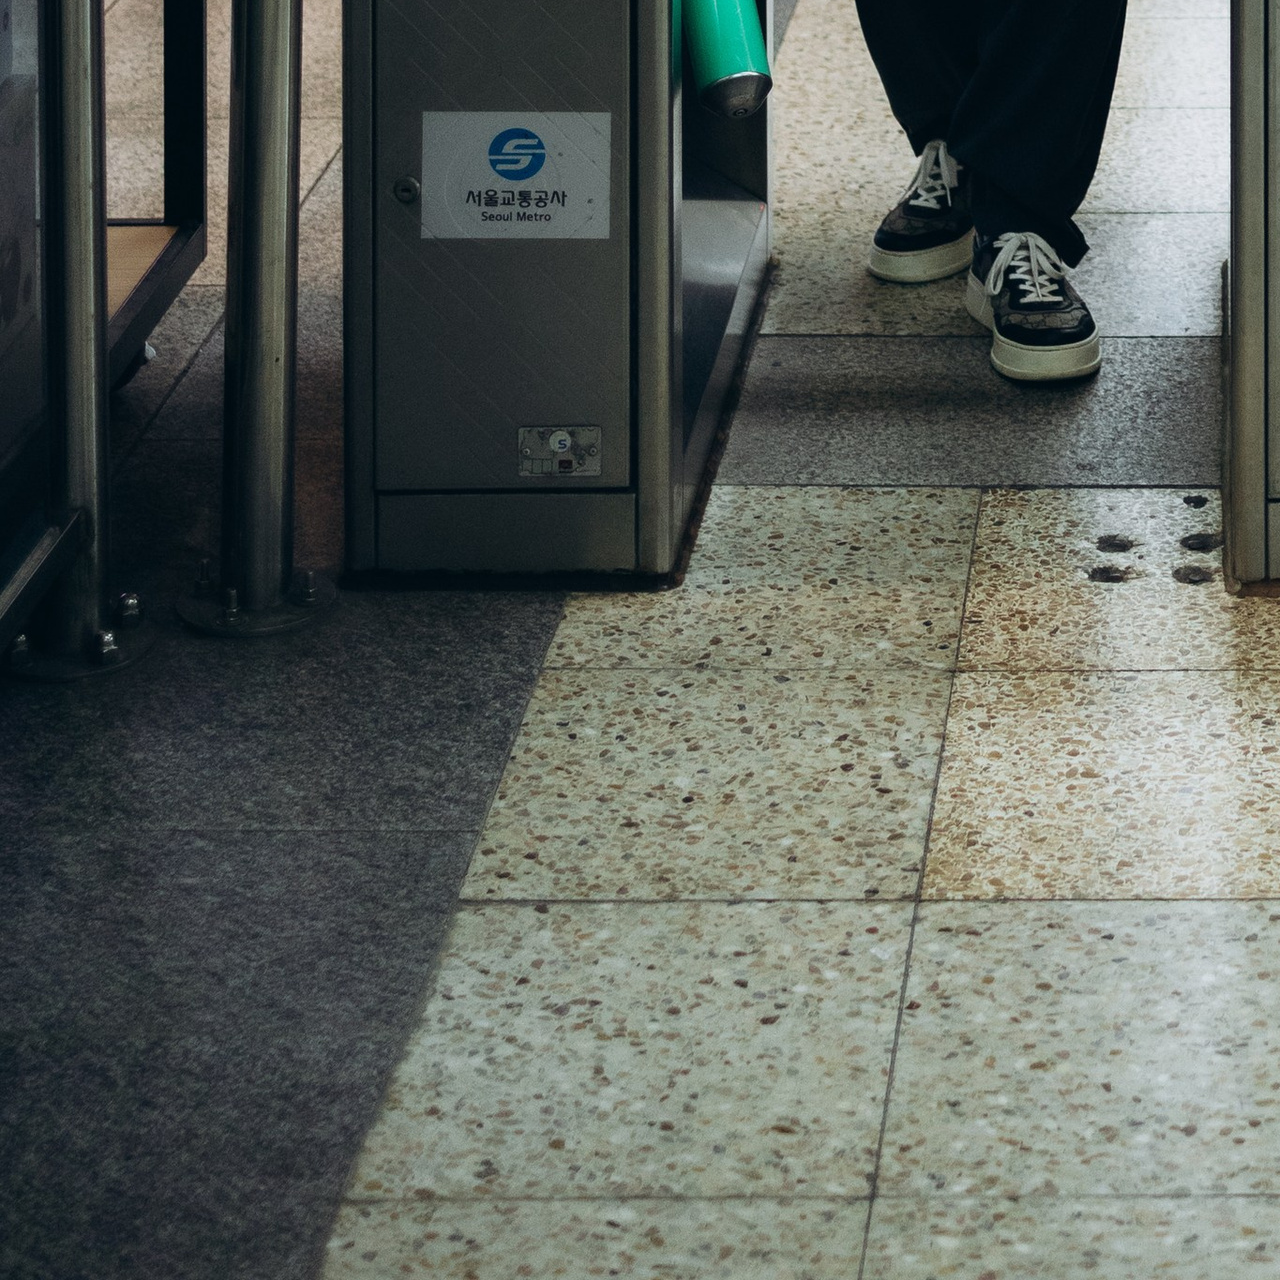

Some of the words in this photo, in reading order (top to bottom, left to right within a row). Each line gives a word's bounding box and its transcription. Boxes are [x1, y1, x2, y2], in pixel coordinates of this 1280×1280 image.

[465, 189, 567, 209] 서울교통공사
[481, 211, 513, 223] Seoul
[516, 211, 552, 223] Metro
